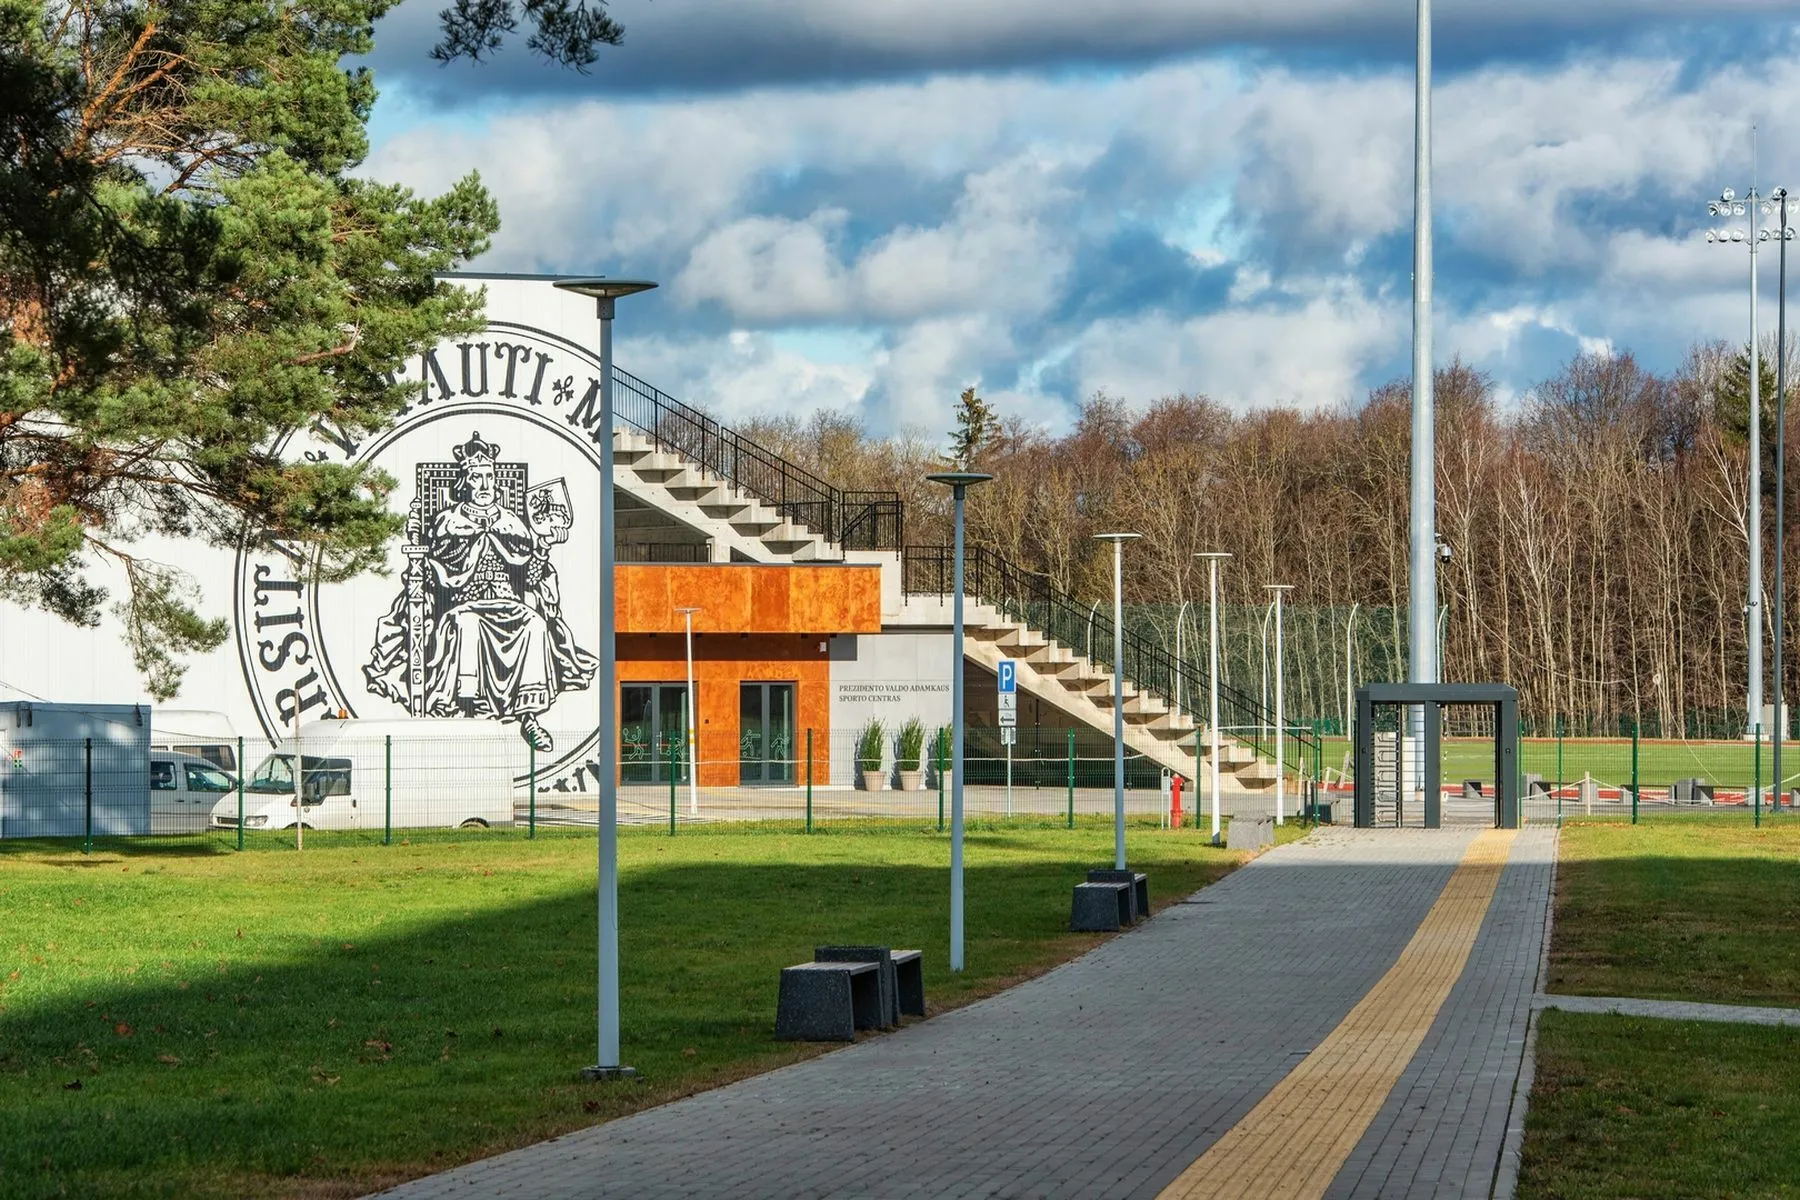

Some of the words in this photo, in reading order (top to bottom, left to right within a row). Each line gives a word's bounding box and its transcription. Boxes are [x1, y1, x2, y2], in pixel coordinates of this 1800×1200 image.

[1002, 664, 1013, 690] P
[839, 684, 884, 692] PREZIDENTO
[885, 684, 909, 692] VALDO
[910, 684, 949, 692] ADAMKAUS
[839, 694, 867, 702] SPORTO
[868, 694, 901, 702] CENTRAS
